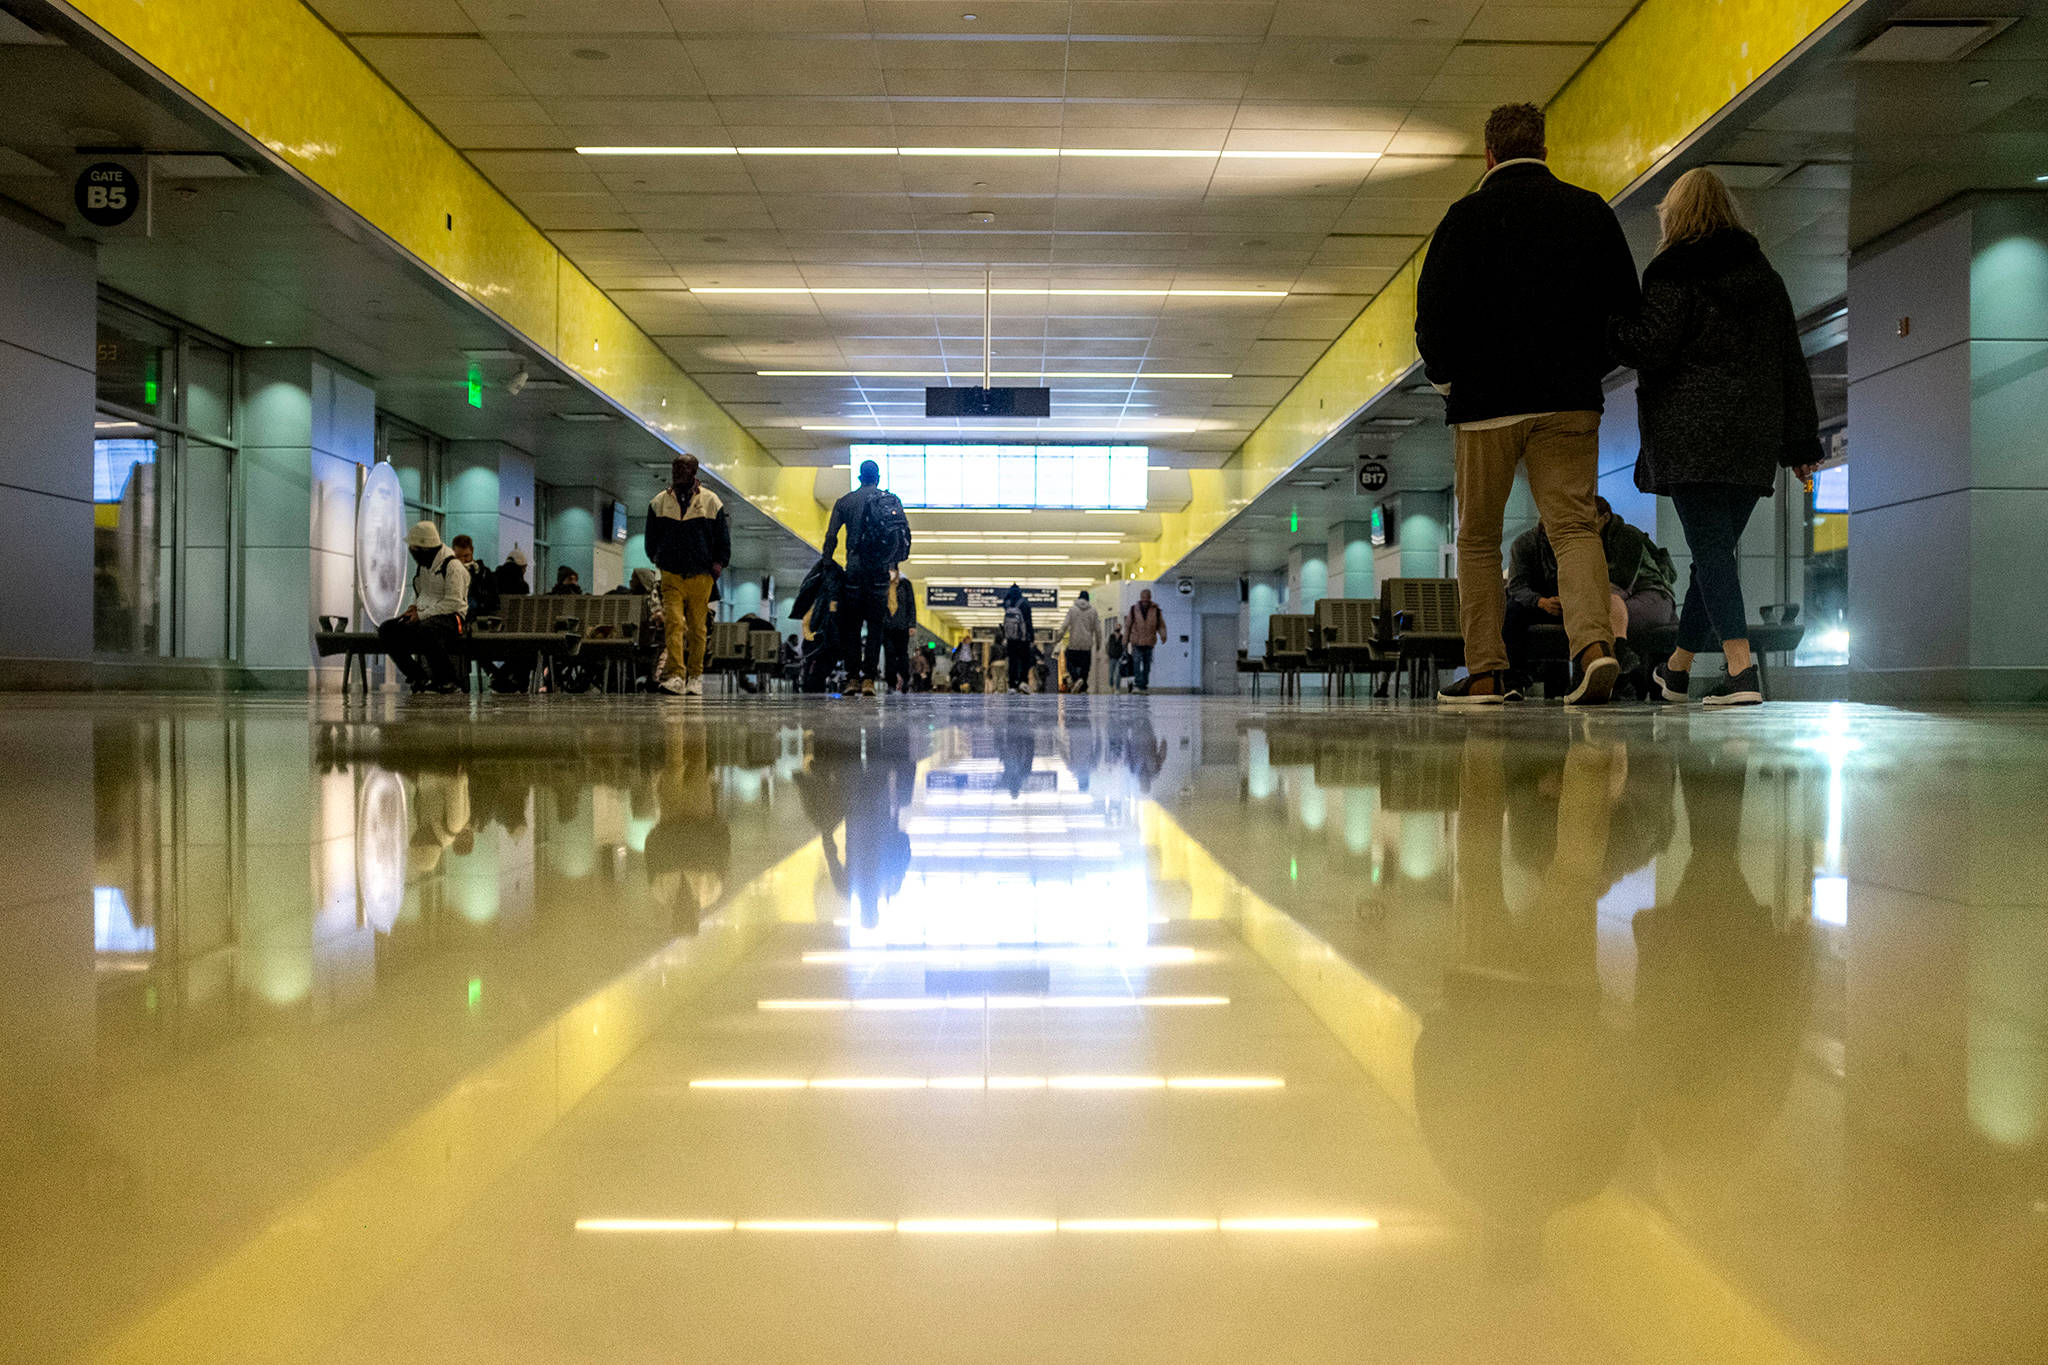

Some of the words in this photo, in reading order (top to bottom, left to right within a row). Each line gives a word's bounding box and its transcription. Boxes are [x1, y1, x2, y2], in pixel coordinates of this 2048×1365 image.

[91, 171, 123, 182] GATE
[87, 186, 127, 209] B5
[1362, 473, 1386, 484] B17
